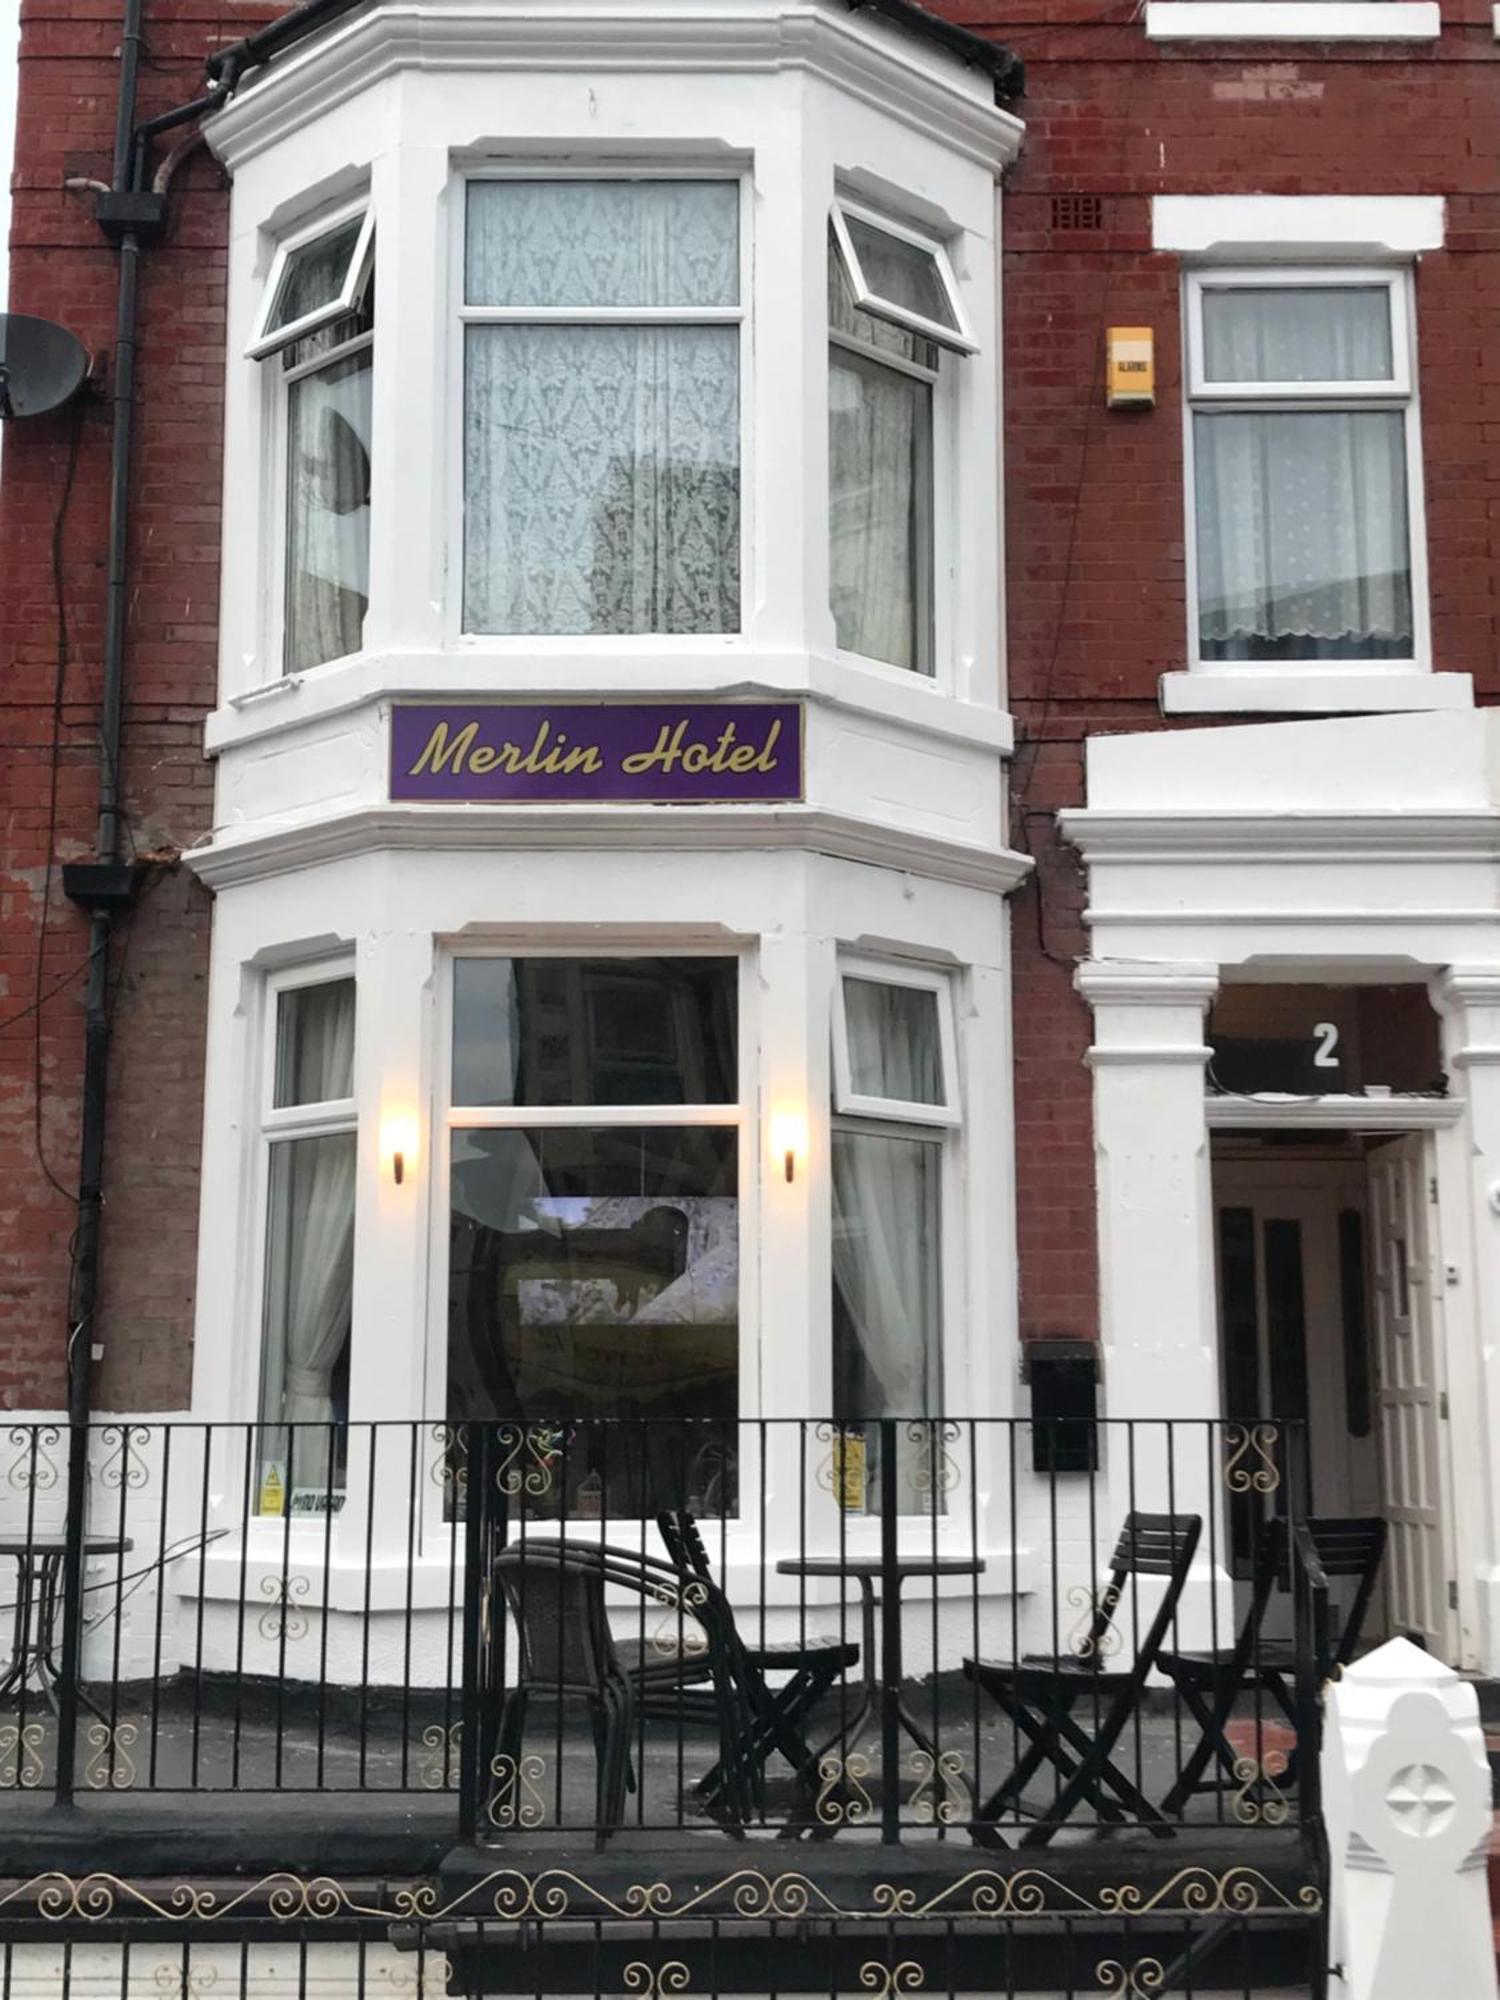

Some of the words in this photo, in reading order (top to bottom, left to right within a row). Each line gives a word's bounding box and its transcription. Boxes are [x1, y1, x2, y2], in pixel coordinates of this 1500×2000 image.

[409, 718, 604, 775] Merlin
[621, 718, 783, 774] Hotel
[1313, 1022, 1340, 1068] 2
